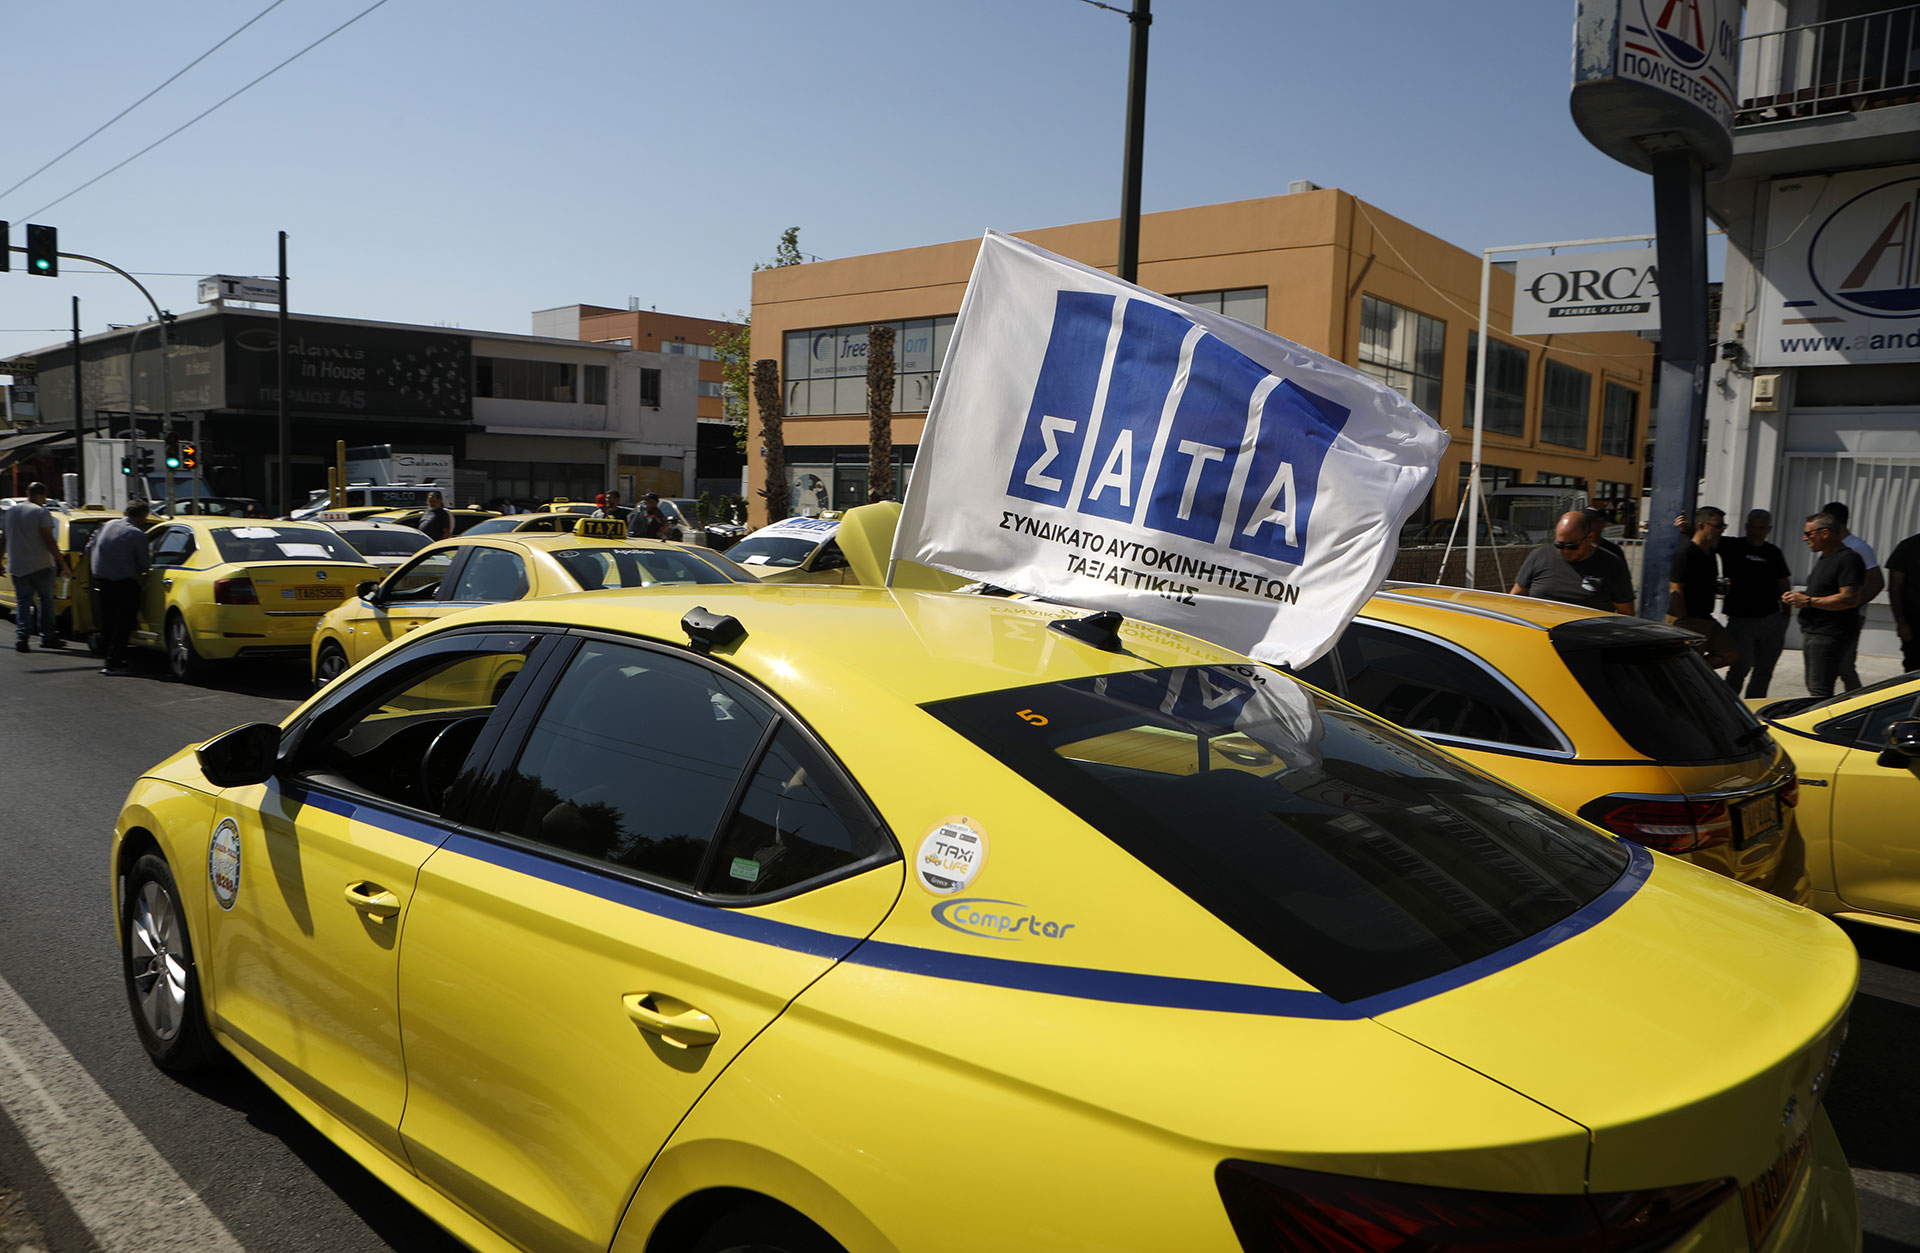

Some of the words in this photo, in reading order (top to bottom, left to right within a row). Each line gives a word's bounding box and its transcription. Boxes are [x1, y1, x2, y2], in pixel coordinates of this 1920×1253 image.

[1524, 265, 1661, 304] ORCA
[1558, 306, 1597, 316] PENNEL
[1609, 304, 1641, 314] FLIPO
[320, 361, 366, 380] House
[337, 389, 368, 409] 45
[1024, 415, 1299, 548] ΣΑΤΑ
[587, 522, 622, 536] TAXI
[999, 511, 1104, 553] ΣΥΝΔΙΚΑΤΟ
[1106, 538, 1301, 605] ΑΥΤΟΚΙΝΗΤΙΣΤΩΝ
[1067, 553, 1104, 580] ΤΑΞΙ
[1104, 567, 1200, 607] ΑΤΤΙΚΗΣ
[931, 877, 949, 887] Greece
